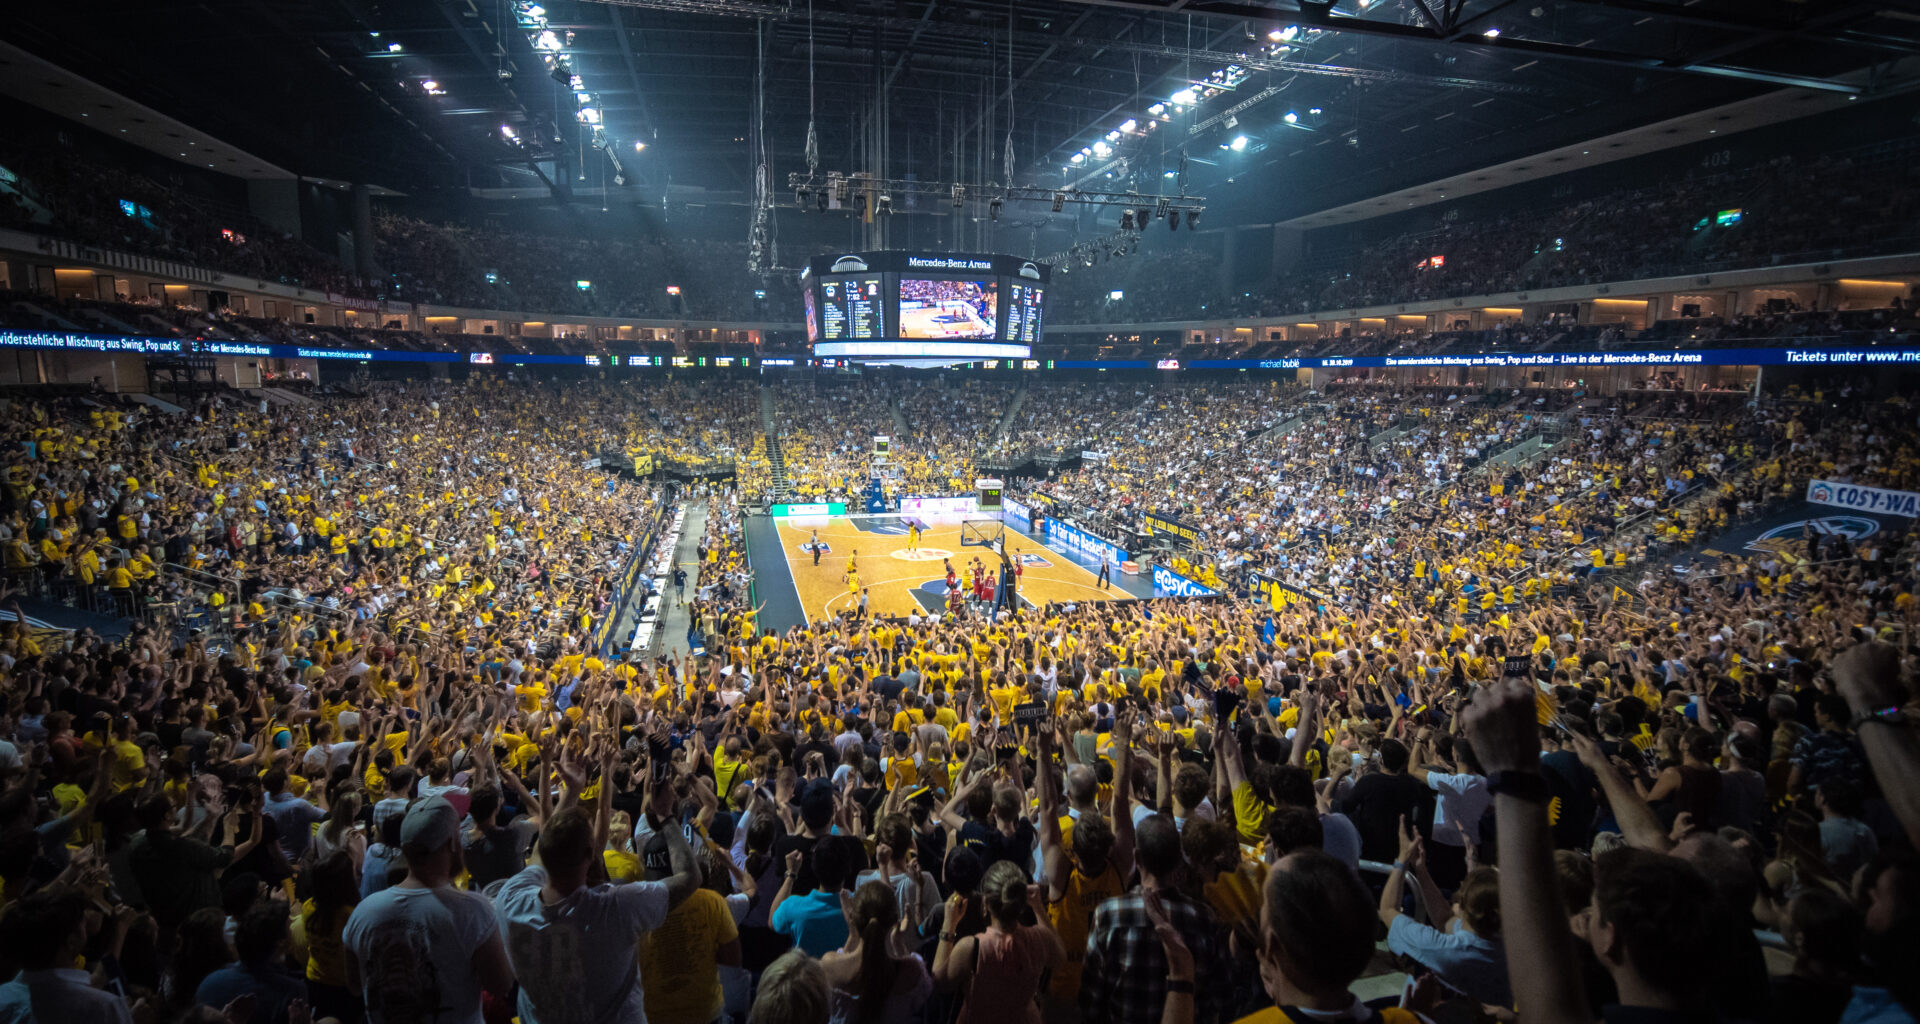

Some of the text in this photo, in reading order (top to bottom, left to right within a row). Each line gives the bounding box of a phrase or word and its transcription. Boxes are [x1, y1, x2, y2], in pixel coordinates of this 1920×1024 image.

[1701, 150, 1730, 168] 403
[909, 257, 991, 268] Mercedes-Benz Arena
[66, 335, 104, 350] Mischung
[106, 340, 120, 348] aus
[121, 339, 145, 352] Swing,
[146, 340, 158, 352] Pop
[160, 340, 172, 350] und
[210, 343, 220, 353] der
[220, 344, 256, 354] Mercedes-Benz
[256, 345, 270, 354] Arena
[1443, 357, 1471, 366] Mischung
[1508, 356, 1520, 365] Pop
[1537, 356, 1554, 364] Soul
[1560, 354, 1578, 364] Live
[1578, 354, 1587, 363] in
[1588, 354, 1603, 363] der
[1604, 353, 1671, 363] Mercedes-Benz
[1672, 352, 1702, 362] Arena
[1786, 350, 1827, 362] Tickets
[1830, 350, 1864, 362] unter
[1260, 359, 1282, 368] michael
[1050, 520, 1056, 534] So
[1058, 522, 1068, 540] fair
[1069, 528, 1080, 546] wie
